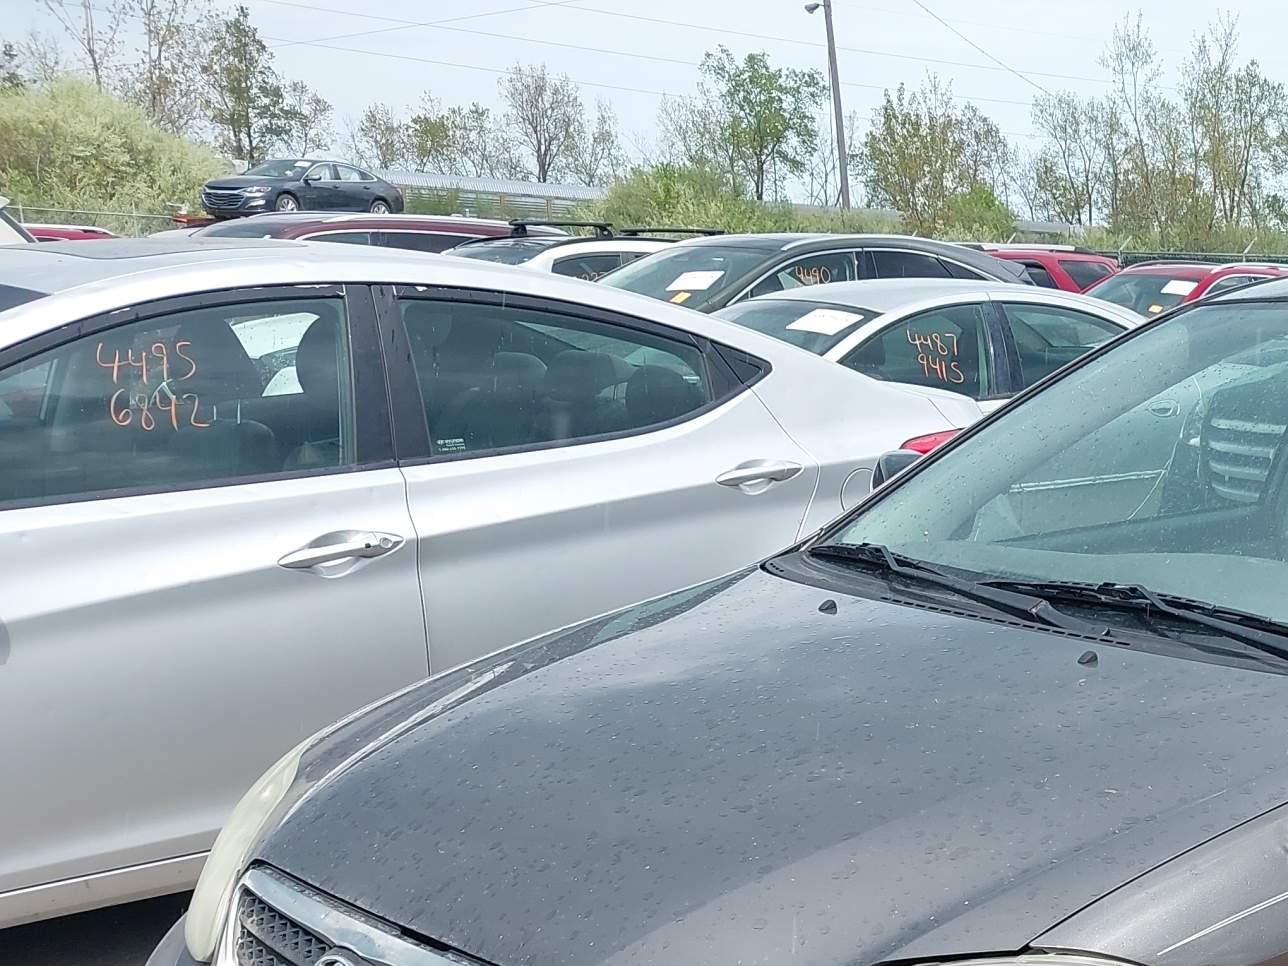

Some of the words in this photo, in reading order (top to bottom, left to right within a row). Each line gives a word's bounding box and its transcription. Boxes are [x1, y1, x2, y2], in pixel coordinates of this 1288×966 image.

[795, 265, 831, 286] 4490
[906, 328, 958, 356] 4487
[97, 341, 196, 384] 4495
[918, 353, 965, 384] 9415
[110, 388, 210, 431] 6842
